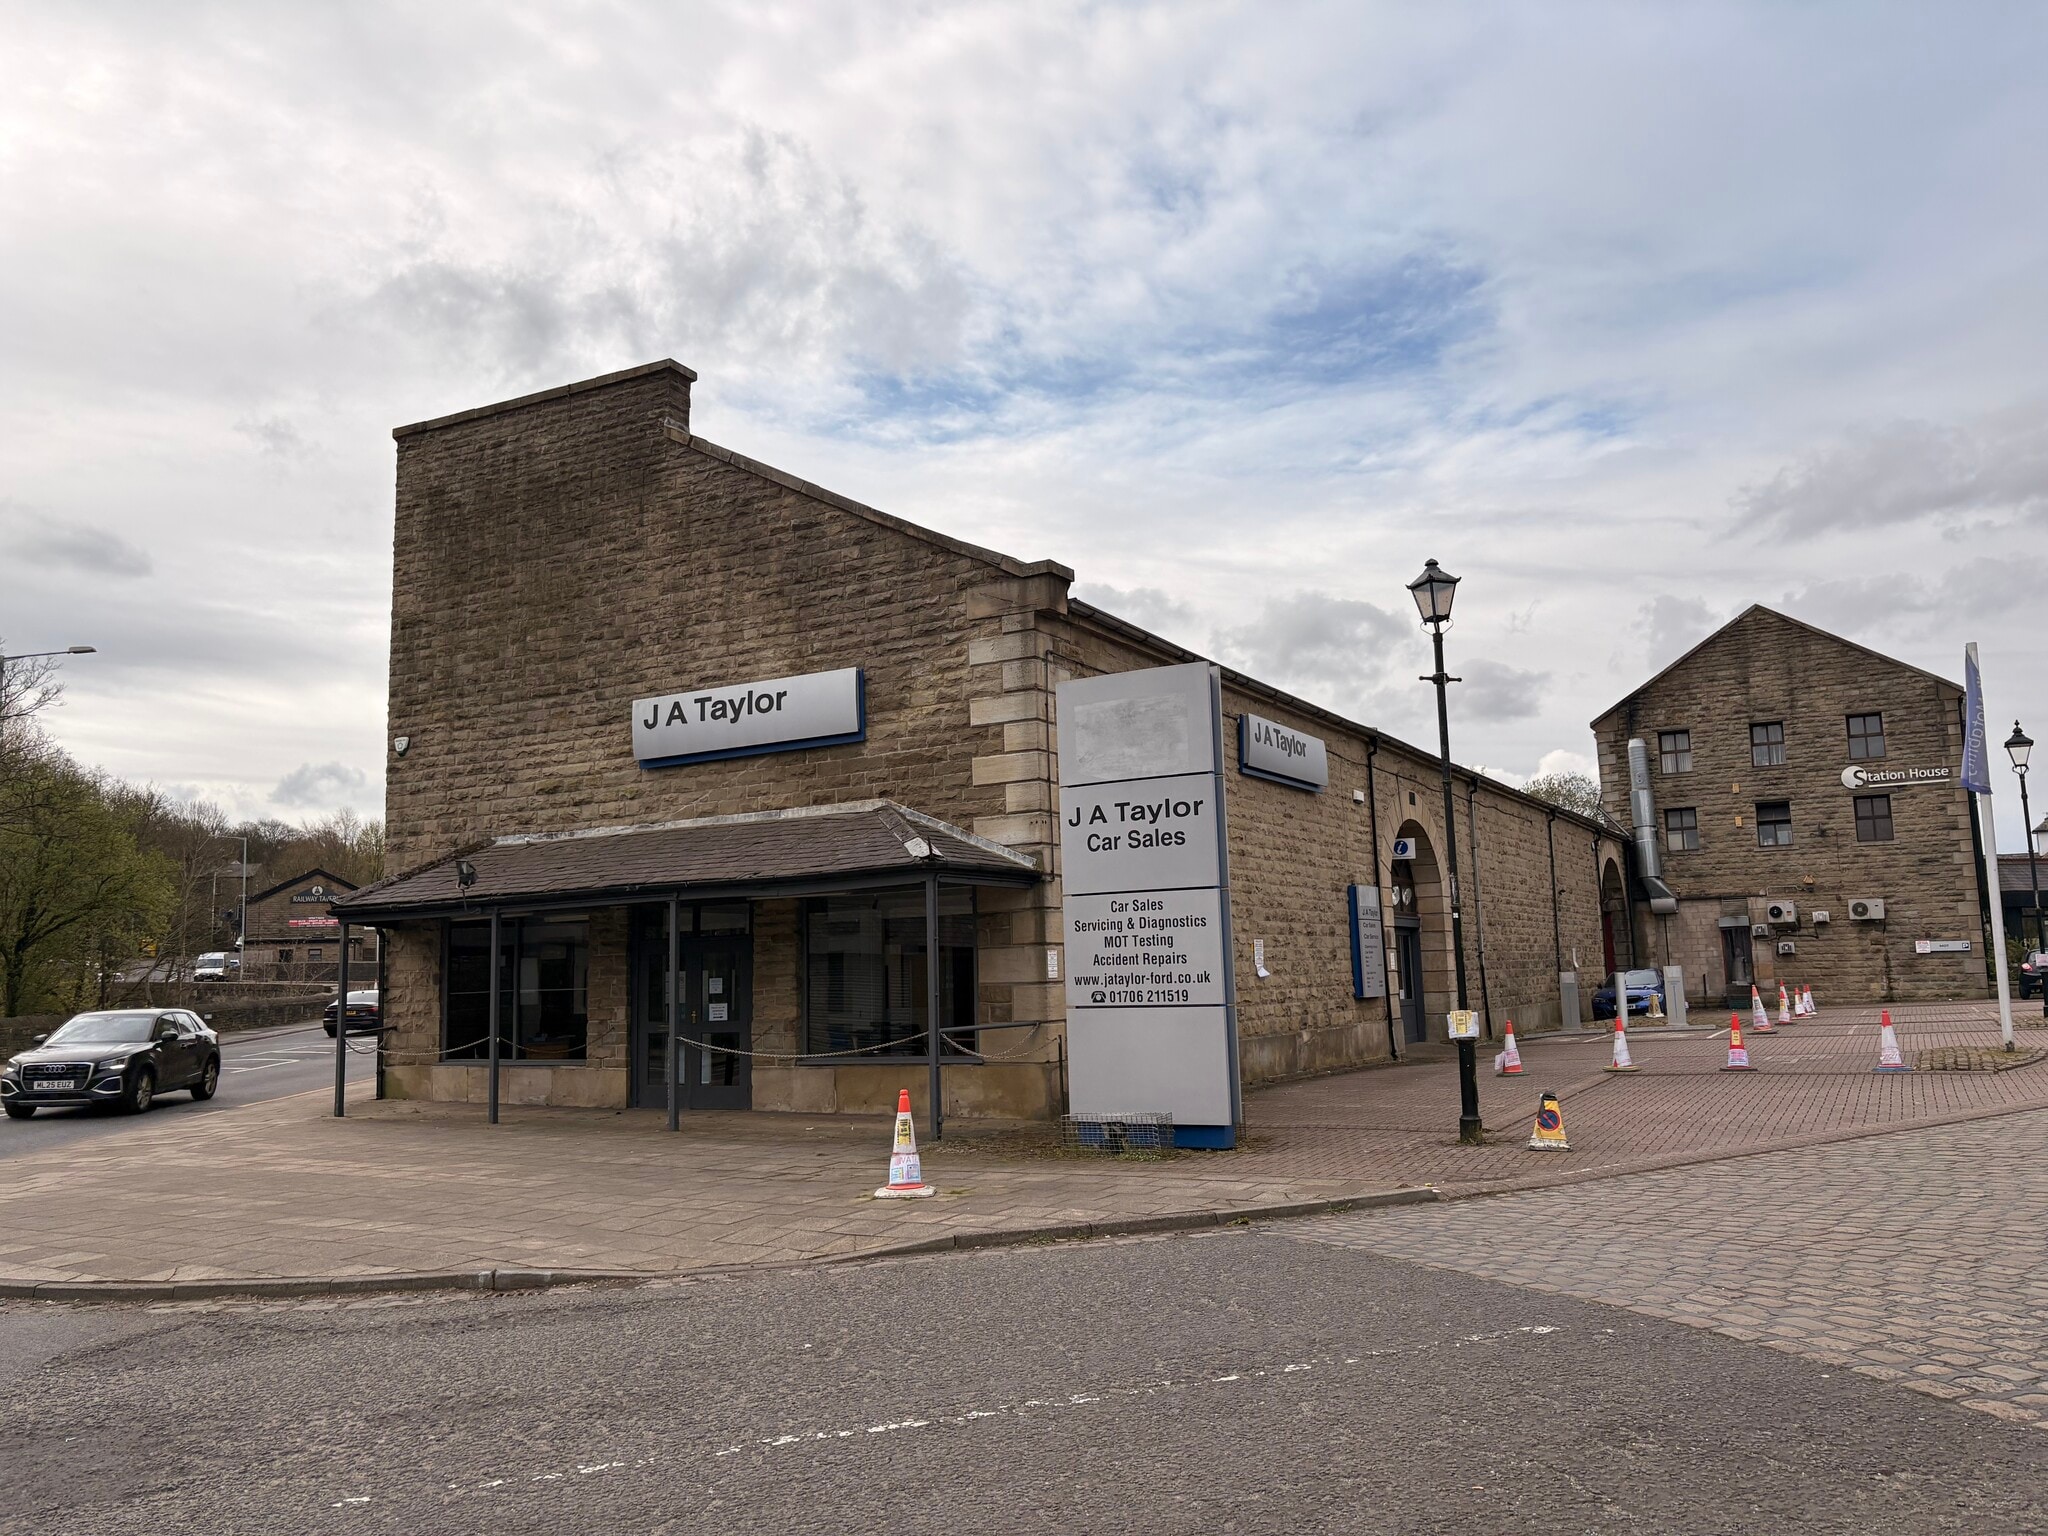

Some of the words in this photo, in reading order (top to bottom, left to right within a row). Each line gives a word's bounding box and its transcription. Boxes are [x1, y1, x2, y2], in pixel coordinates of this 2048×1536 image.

[643, 704, 659, 730] J
[665, 701, 688, 726] A
[694, 690, 788, 724] Taylor
[1254, 722, 1261, 743] J
[1263, 725, 1273, 747] A
[1273, 727, 1307, 758] Taylor
[1850, 768, 1906, 787] Station
[1909, 767, 1950, 778] House
[1068, 807, 1081, 827] J
[1088, 804, 1108, 825] A
[1114, 798, 1204, 824] Taylor
[1087, 833, 1121, 852] Car
[1127, 828, 1186, 849] Sales
[292, 895, 318, 903] RAILWAY
[1110, 900, 1129, 913] Car
[1132, 898, 1164, 912] Sales
[1074, 919, 1123, 933] Servicing
[1127, 917, 1135, 930] &
[1139, 914, 1207, 931] Diagnostics
[1104, 935, 1129, 949] MOT
[1131, 933, 1174, 949] Testing
[1093, 953, 1139, 966] Accident
[1142, 951, 1188, 968] Repairs
[1074, 970, 1211, 988] www.jataylor-ford.co.uk
[1109, 990, 1144, 1003] 01706
[1146, 989, 1189, 1003] 211519
